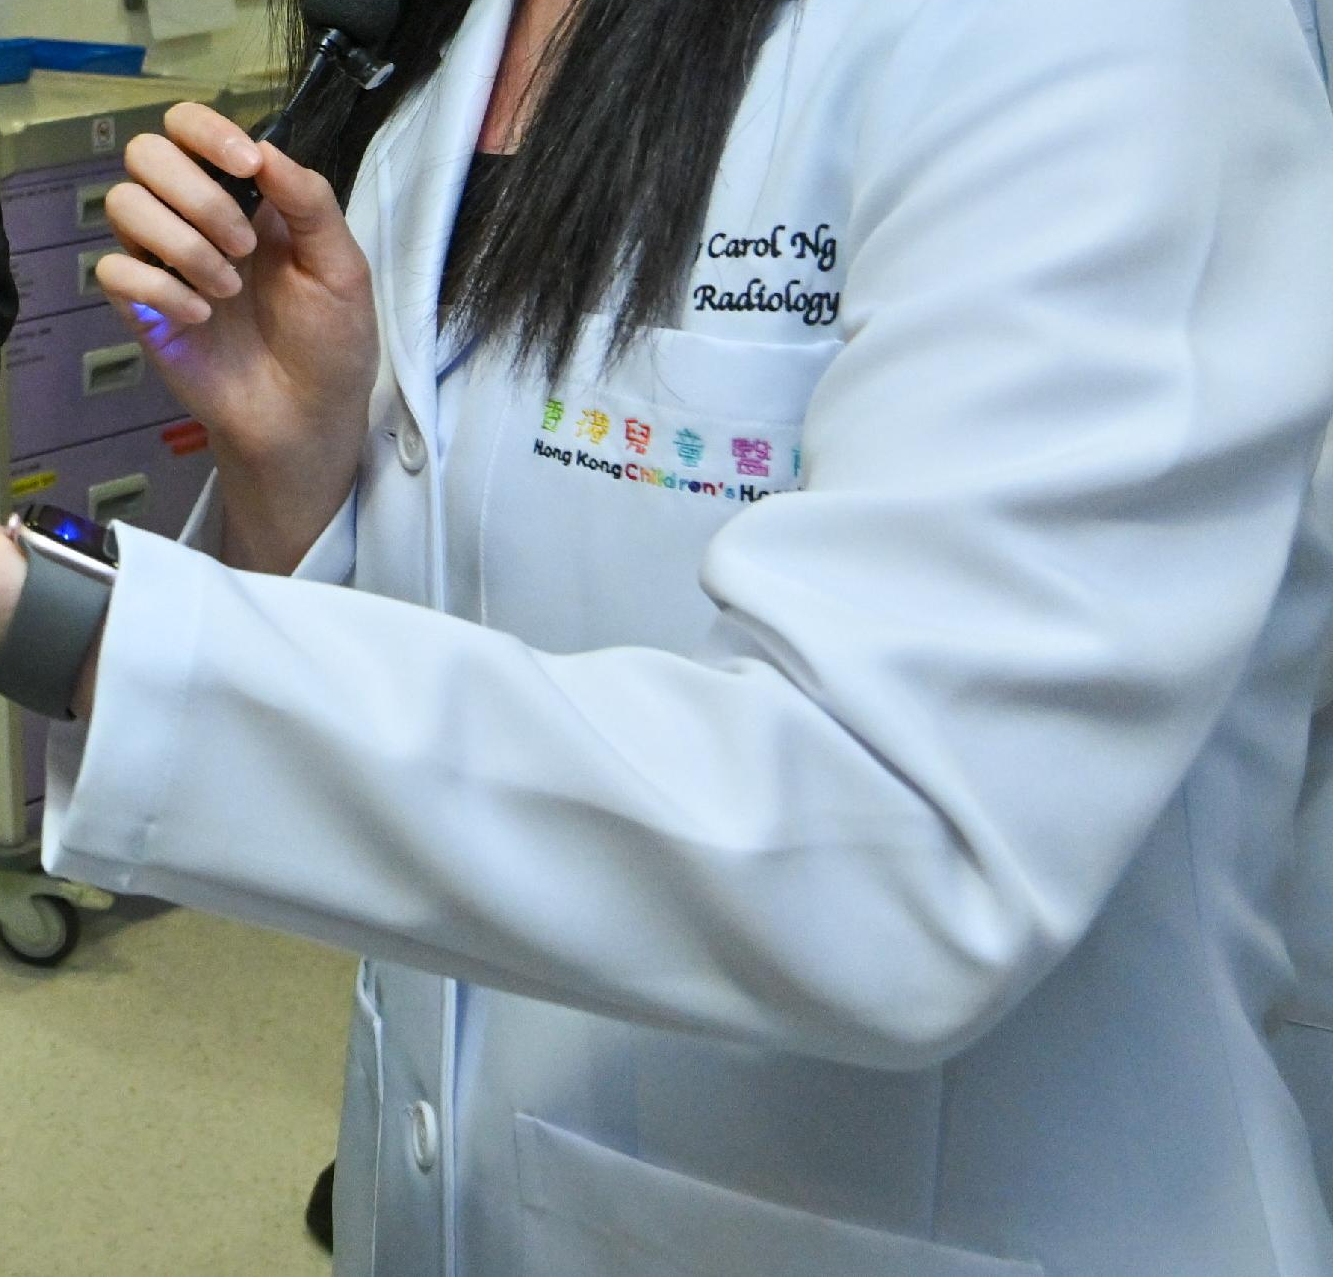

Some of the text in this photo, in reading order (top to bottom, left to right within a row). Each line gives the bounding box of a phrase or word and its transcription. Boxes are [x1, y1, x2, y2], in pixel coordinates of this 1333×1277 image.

[707, 224, 786, 259] Carol
[790, 223, 837, 272] Ng
[693, 277, 840, 326] Radiology
[533, 438, 573, 467] Hong
[575, 449, 622, 480] Kong
[624, 462, 736, 500] Children's
